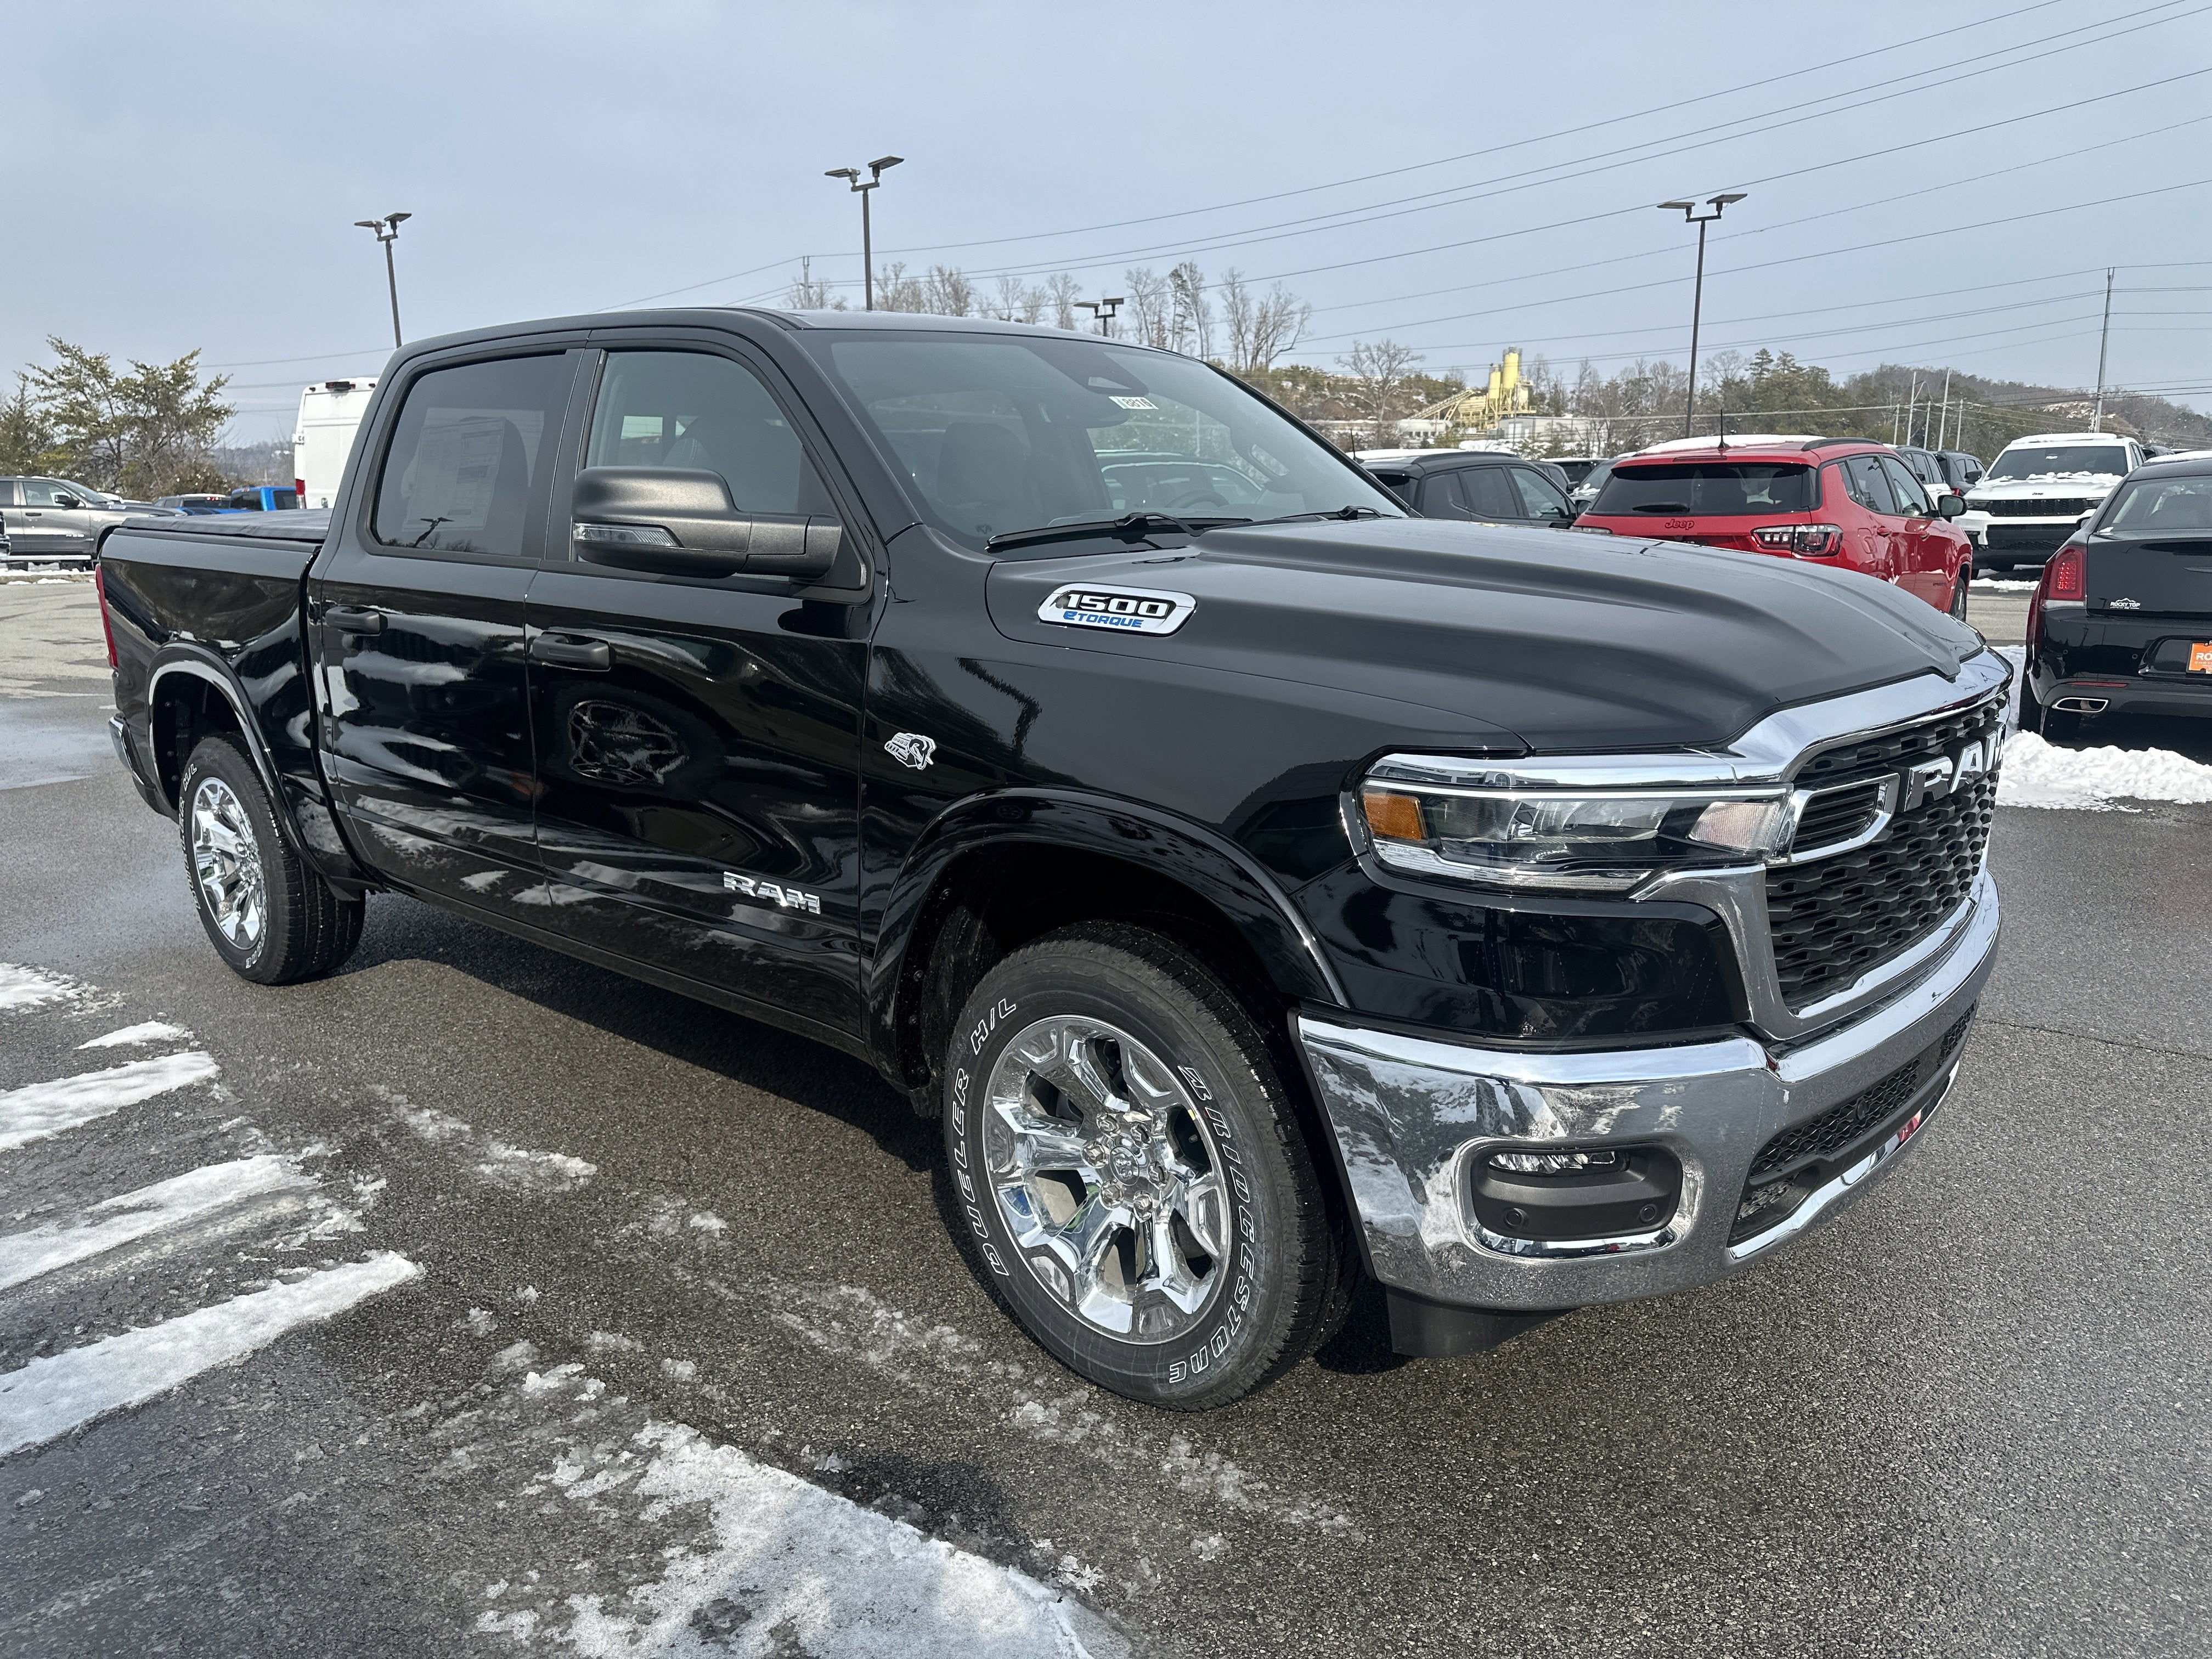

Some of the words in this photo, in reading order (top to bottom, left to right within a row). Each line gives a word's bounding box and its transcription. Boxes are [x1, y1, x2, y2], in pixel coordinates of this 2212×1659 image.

[1664, 518, 1695, 531] Jeep
[1068, 593, 1170, 618] 1500
[1904, 723, 2006, 812] RAM
[723, 871, 821, 915] RAM
[952, 1068, 1010, 1277] DUELER
[1169, 1065, 1255, 1384] BRIDGESTONE
